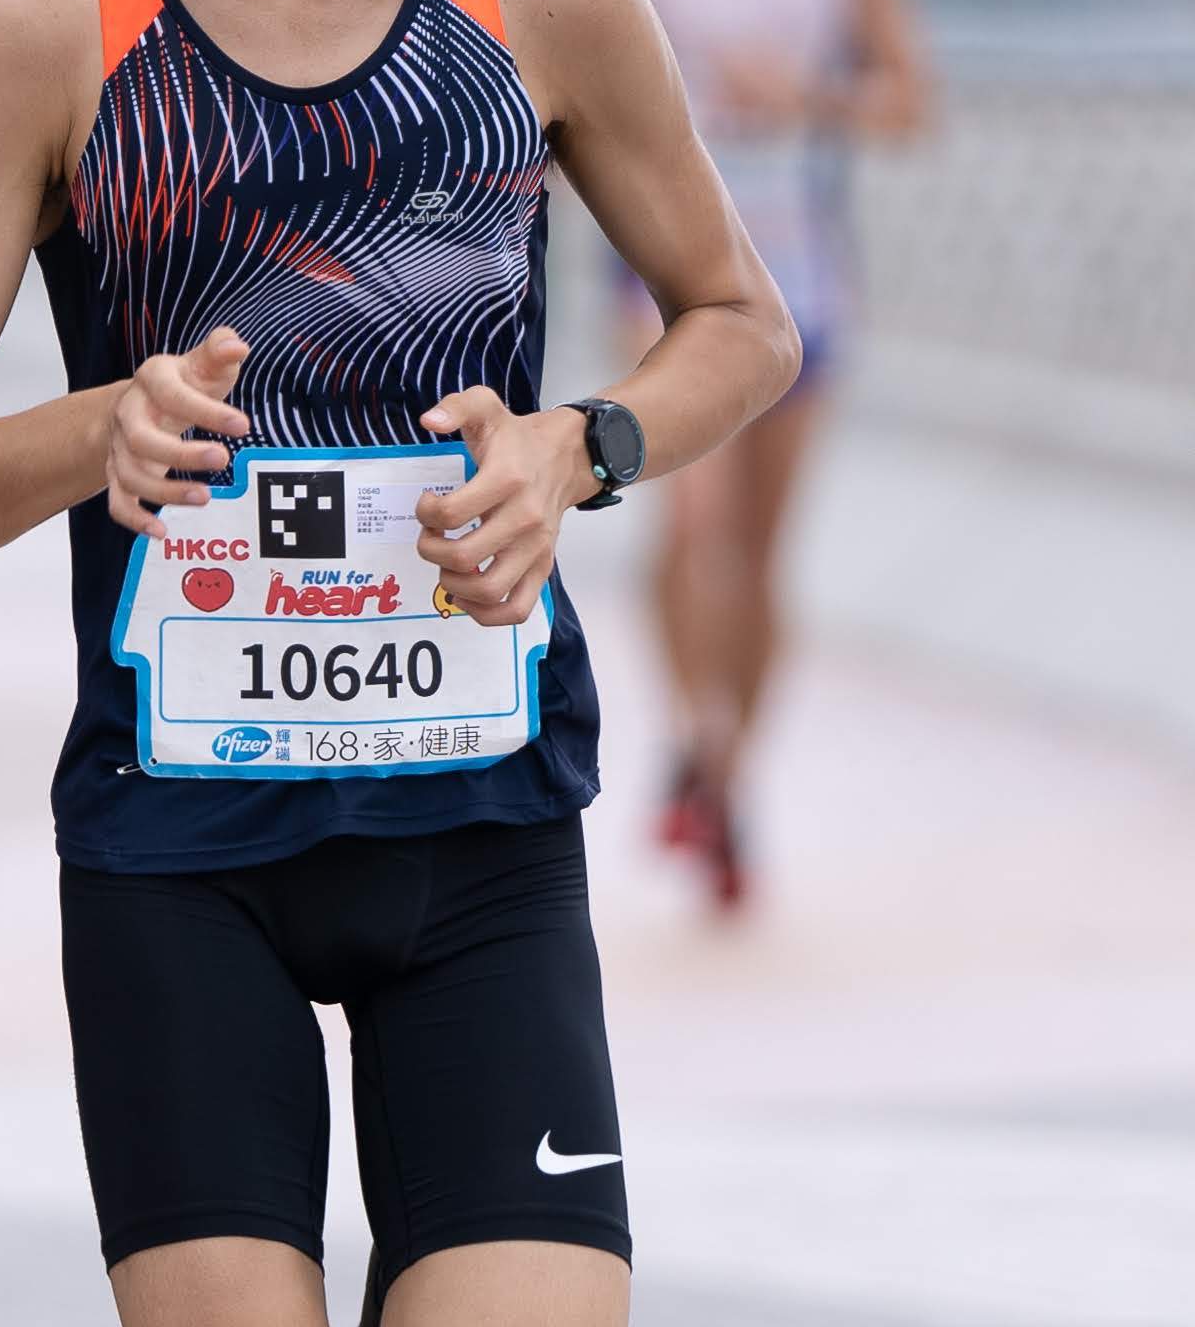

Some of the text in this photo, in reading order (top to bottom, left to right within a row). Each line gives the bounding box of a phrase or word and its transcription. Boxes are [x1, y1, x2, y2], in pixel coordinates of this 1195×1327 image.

[163, 538, 251, 561] HKCC
[264, 571, 401, 616] heart
[301, 570, 374, 585] RUN for
[239, 639, 443, 702] 10640
[215, 730, 271, 763] Pfizer
